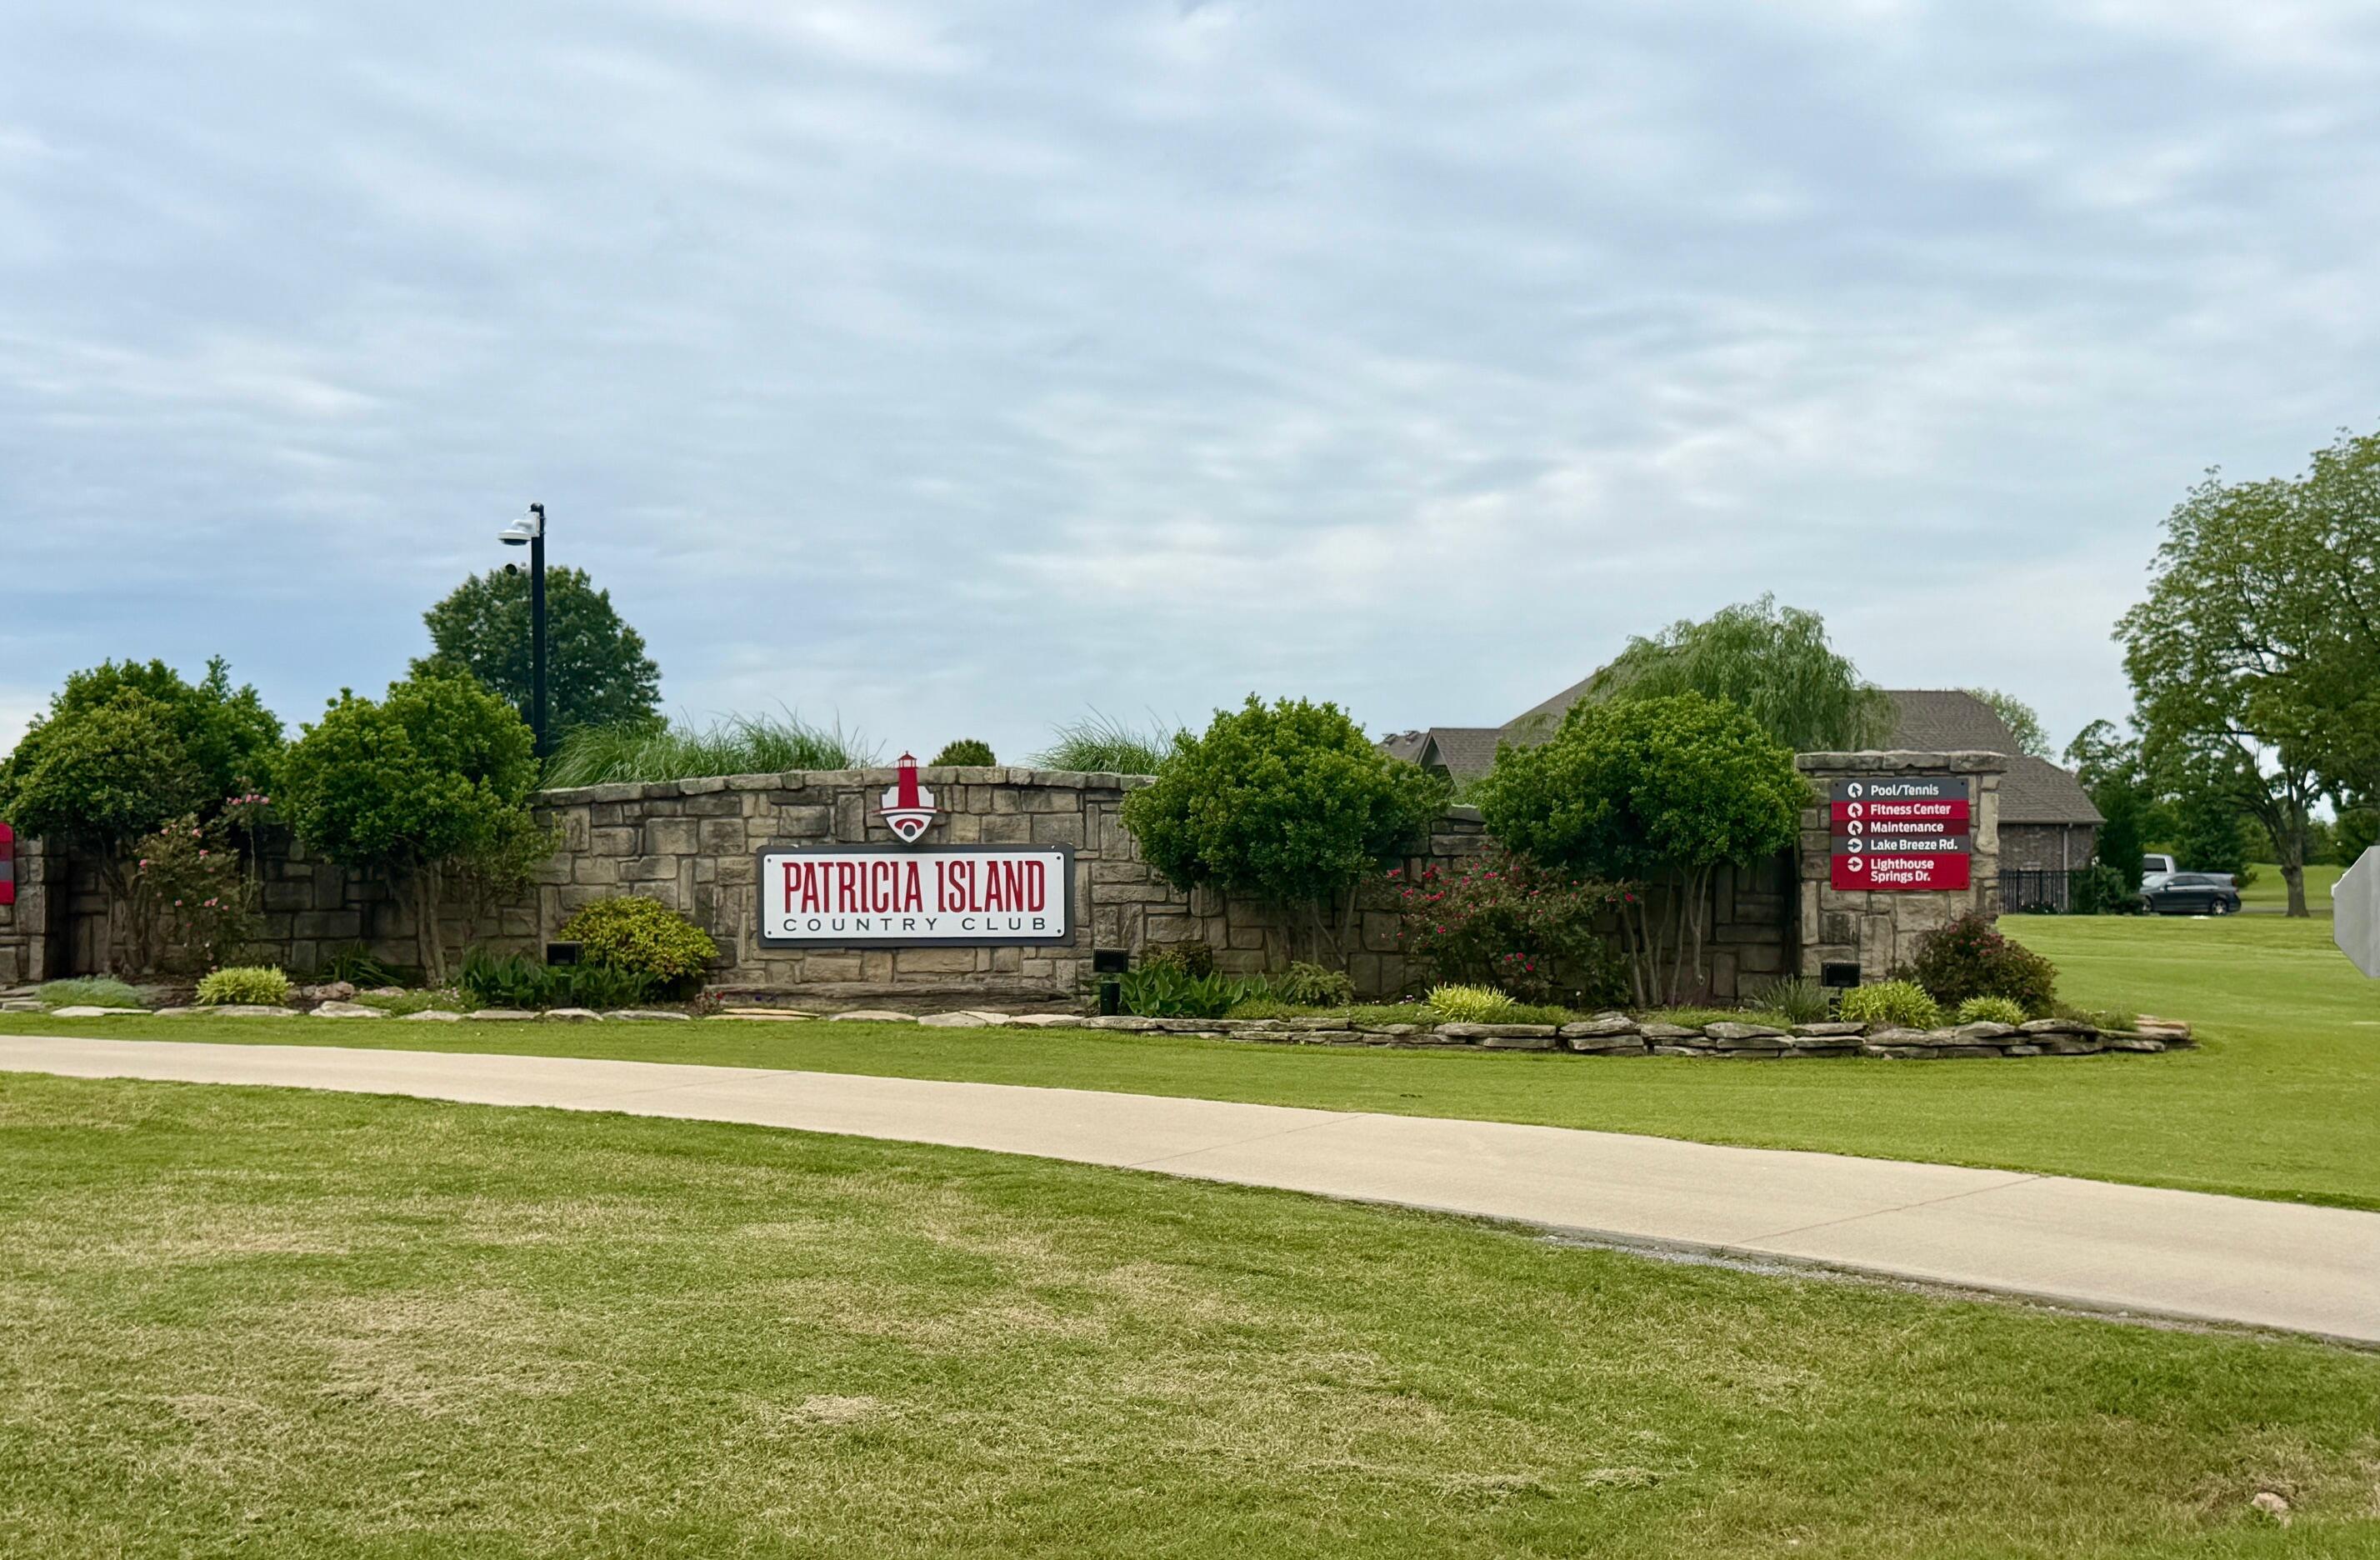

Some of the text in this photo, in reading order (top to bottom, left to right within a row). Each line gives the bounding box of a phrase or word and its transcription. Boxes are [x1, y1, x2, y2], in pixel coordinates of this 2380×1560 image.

[1870, 784, 1939, 797] Pool/Tennis
[1870, 803, 1951, 816] Fitness Center
[1870, 822, 1944, 833] Maintenance
[1870, 838, 1958, 851] Lake Breeze Rd.
[1870, 858, 1934, 871] Lighthouse
[1870, 871, 1931, 883] Springs Dr.
[782, 860, 1045, 913] PATRICIA ISLAND
[783, 918, 1046, 932] COUNTRY CLUB
